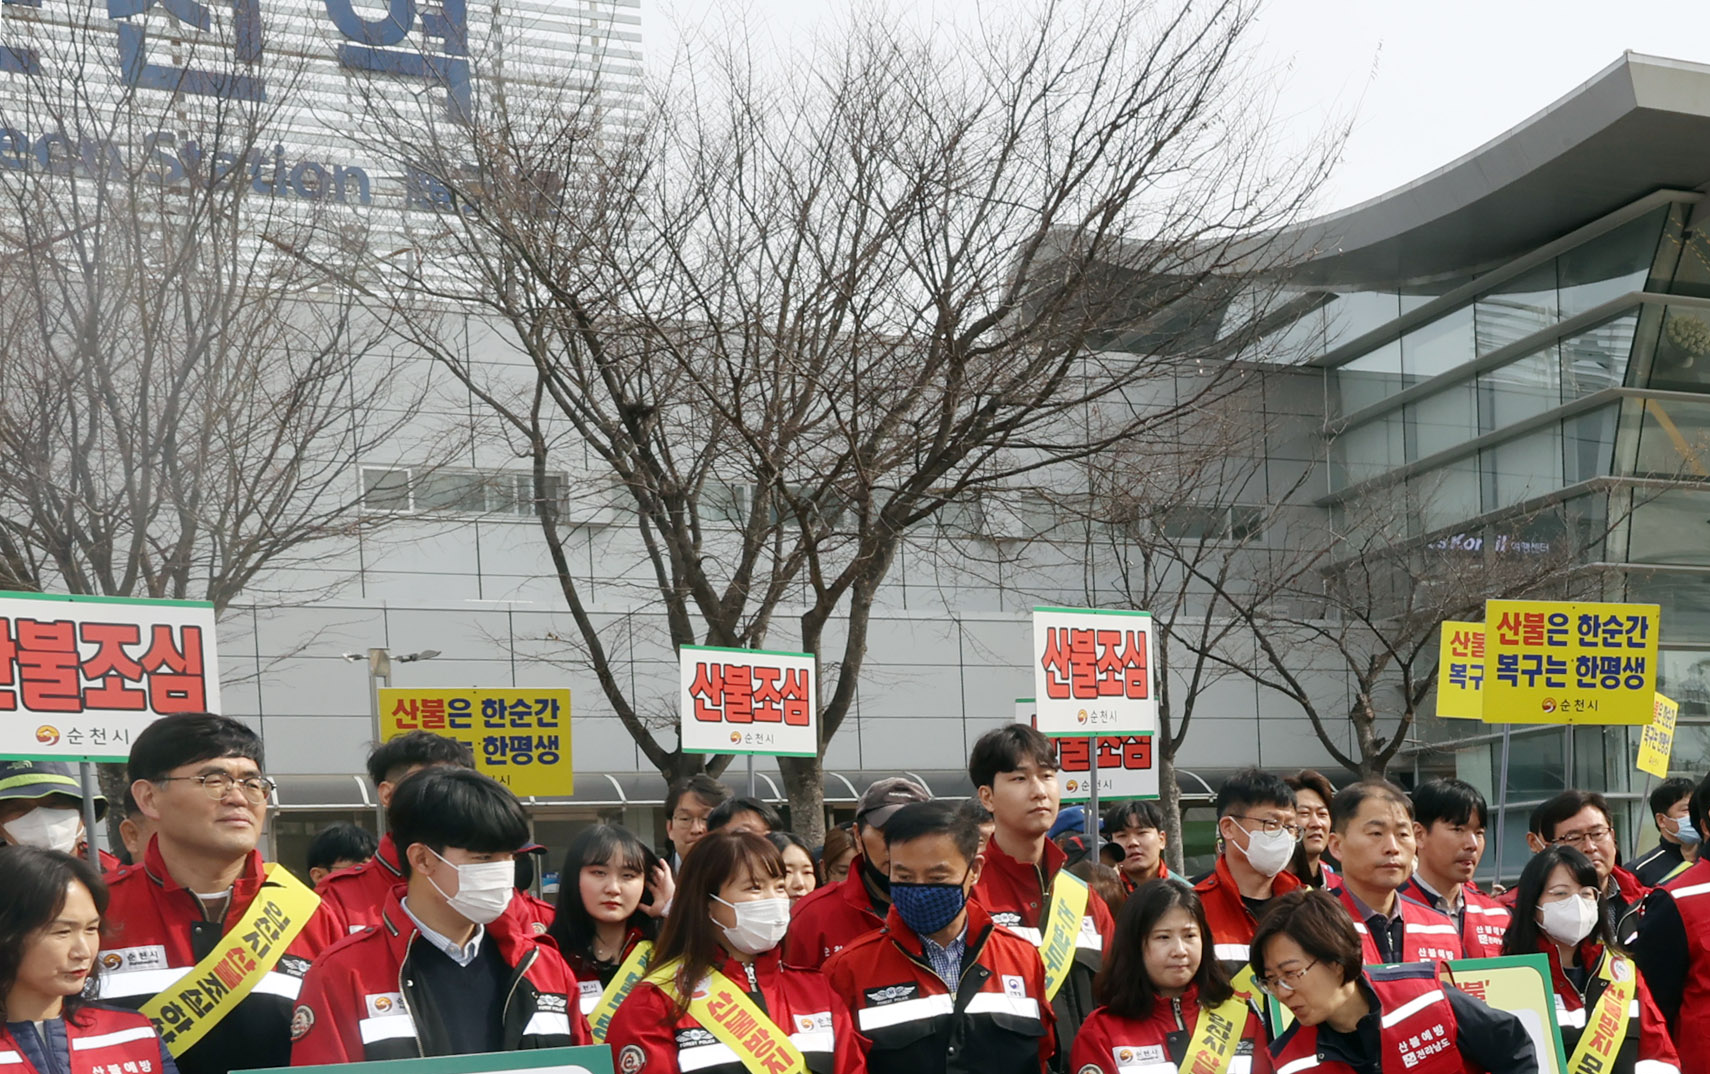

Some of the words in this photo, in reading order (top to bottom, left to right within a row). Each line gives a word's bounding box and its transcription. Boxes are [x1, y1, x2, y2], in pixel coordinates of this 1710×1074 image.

[1496, 612, 1569, 647] 산불은
[1577, 614, 1649, 648] 한순간
[0, 617, 207, 715] 불조심
[1042, 627, 1148, 699] 산불조심
[1496, 654, 1567, 688] 복구는
[1575, 655, 1646, 690] 한평생
[689, 662, 809, 726] 산불조심
[1559, 699, 1599, 712] 순천시
[391, 698, 472, 729] 산불은
[481, 698, 560, 729] 한순간
[1090, 709, 1118, 723] 순천시
[67, 727, 129, 745] 순천시
[482, 735, 560, 765] 한평생
[744, 732, 775, 744] 순천시
[179, 947, 257, 1020] 산불조심
[1202, 1011, 1234, 1057] 입산시
[1588, 983, 1625, 1057] 산불방지
[1398, 1023, 1445, 1054] 산불예방
[1416, 1037, 1451, 1060] 전라남도
